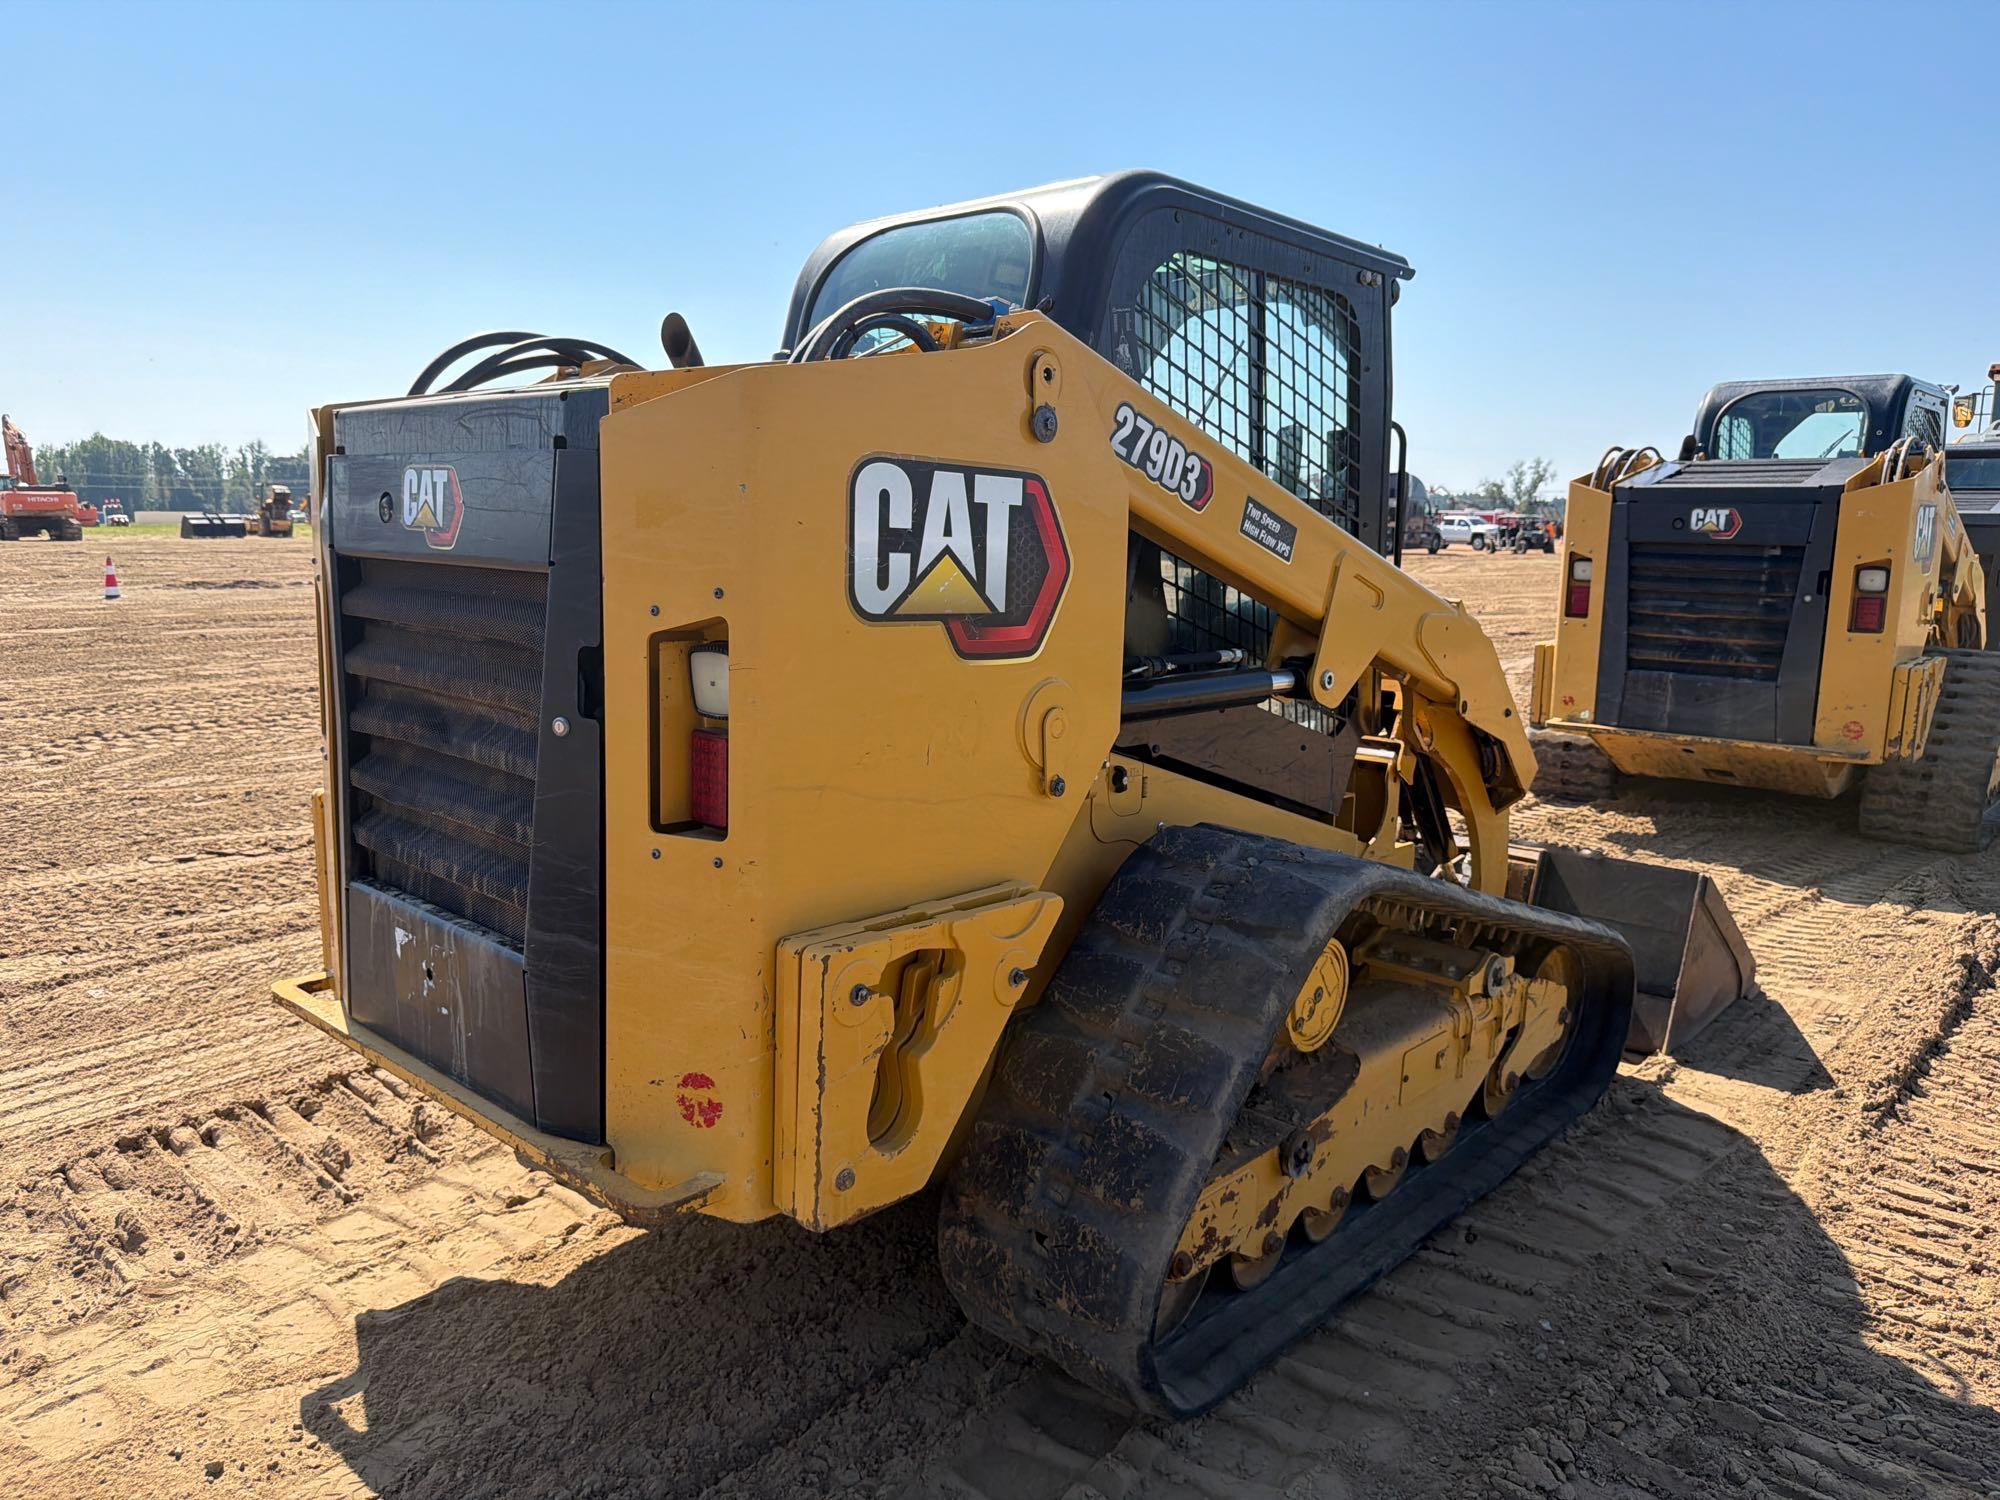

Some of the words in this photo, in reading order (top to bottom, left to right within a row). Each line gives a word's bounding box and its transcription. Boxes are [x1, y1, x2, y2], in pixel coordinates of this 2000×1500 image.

[1111, 405, 1201, 501] 279D3
[403, 468, 449, 528] CAT
[1690, 508, 1729, 531] CAT
[854, 462, 1023, 614] CAT
[1276, 540, 1291, 557] XPS
[1914, 506, 1936, 559] CAT
